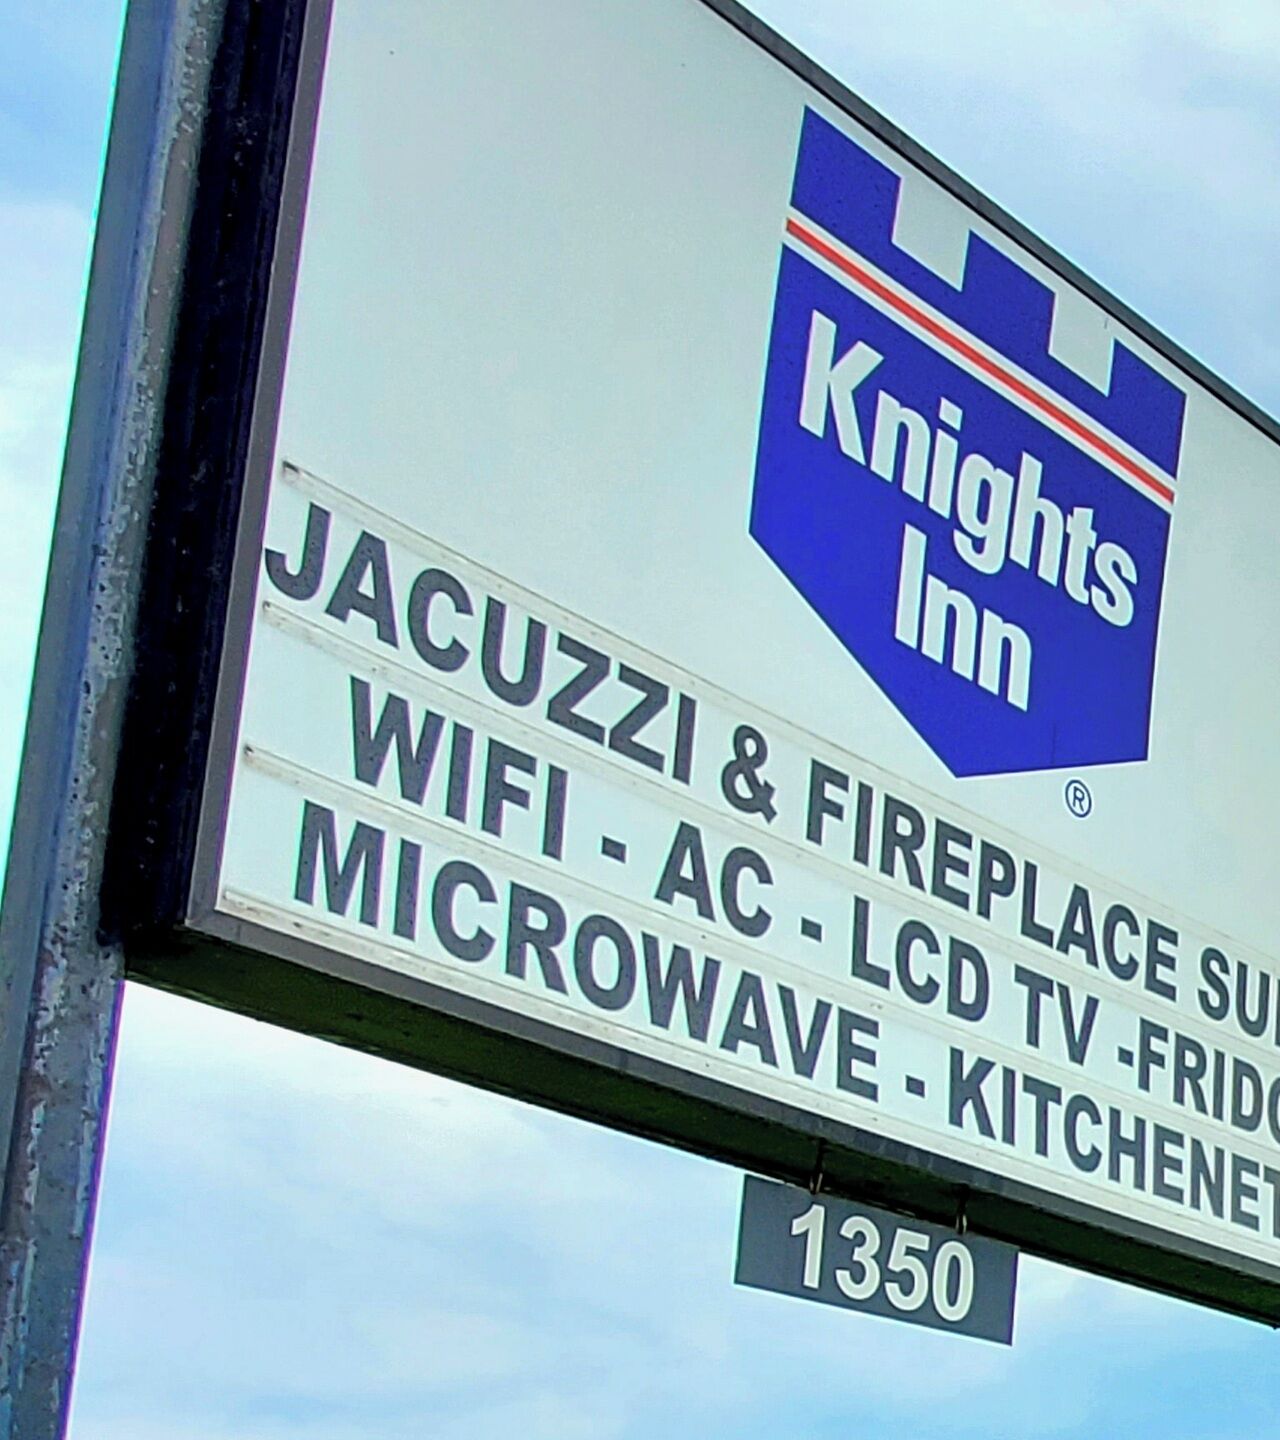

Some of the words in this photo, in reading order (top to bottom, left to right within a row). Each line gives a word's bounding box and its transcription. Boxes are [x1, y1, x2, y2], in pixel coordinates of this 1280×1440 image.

[799, 309, 1138, 627] Knights
[894, 523, 1032, 712] Inn
[264, 501, 696, 785] JACUZZI
[720, 724, 778, 823] &
[806, 758, 1178, 1002] FIREPLACE
[350, 675, 568, 861] WIFI
[654, 821, 773, 938] AC
[851, 895, 989, 1022] LCD
[1014, 964, 1100, 1066] TV
[294, 799, 879, 1103] MICROWAVE
[789, 1204, 974, 1322] 1350
